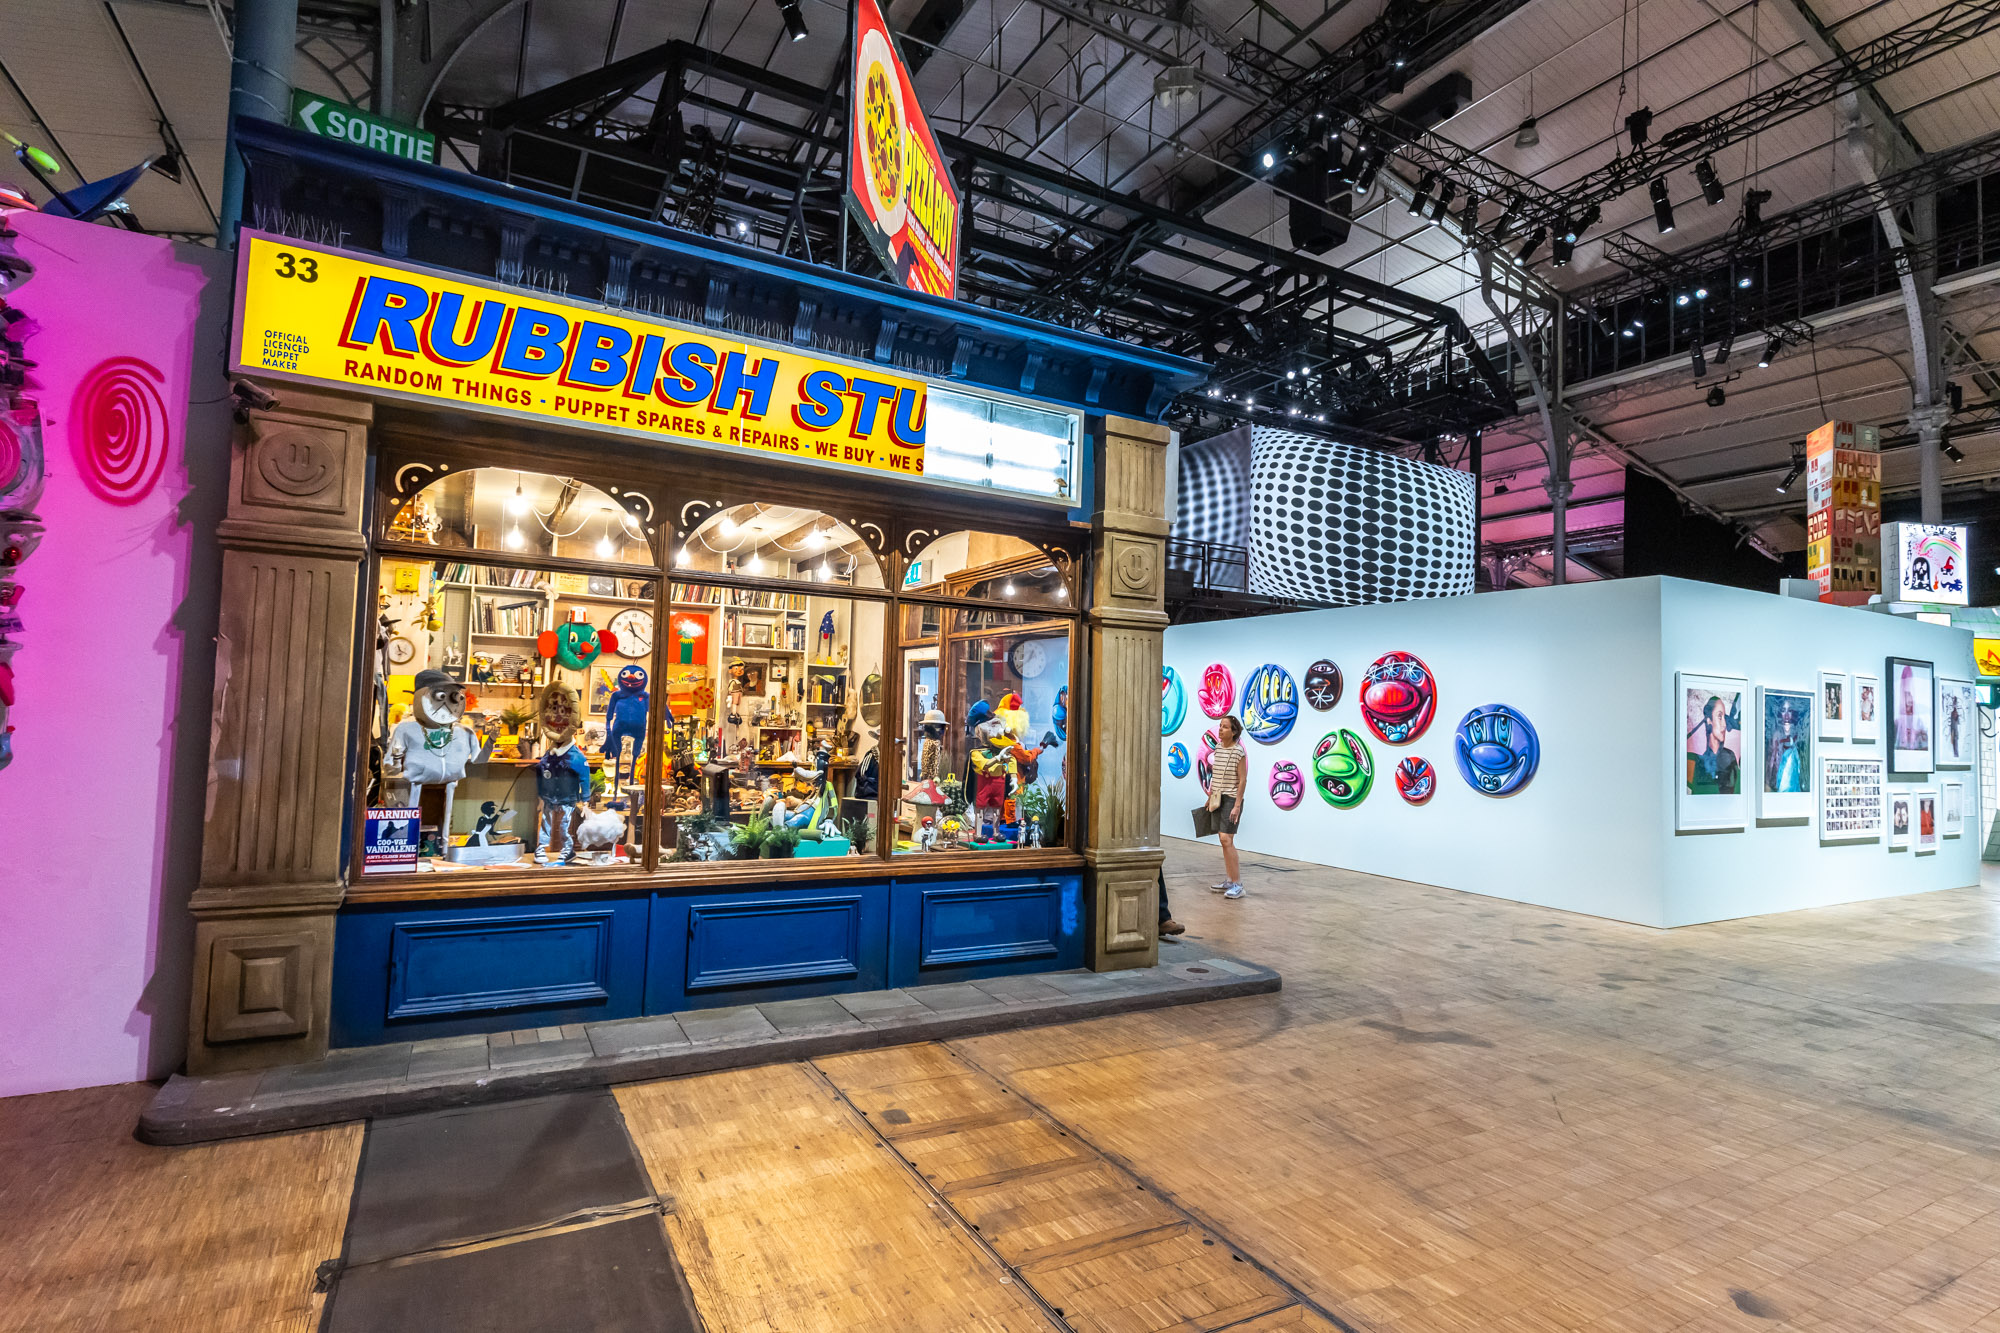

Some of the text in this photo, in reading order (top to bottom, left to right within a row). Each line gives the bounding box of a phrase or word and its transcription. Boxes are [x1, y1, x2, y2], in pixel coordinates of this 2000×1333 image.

[326, 111, 434, 164] SORTIE
[274, 252, 319, 284] 33
[264, 329, 308, 345] OFFICIAL
[263, 338, 310, 354] LICENCED
[263, 348, 300, 362] PUPPET
[338, 275, 928, 451] RUBBISH STU
[262, 357, 298, 371] MAKER
[344, 359, 443, 392] RANDOM
[452, 377, 532, 406] THINGS
[554, 395, 630, 423] PUPPET
[636, 408, 706, 435] SPARES
[712, 424, 723, 438] &
[729, 425, 800, 452] REPAIRS
[815, 440, 839, 458] WE
[843, 446, 876, 464] BUY
[889, 452, 912, 470] WE
[367, 810, 420, 819] WARNING
[366, 844, 417, 854] VANDALENE
